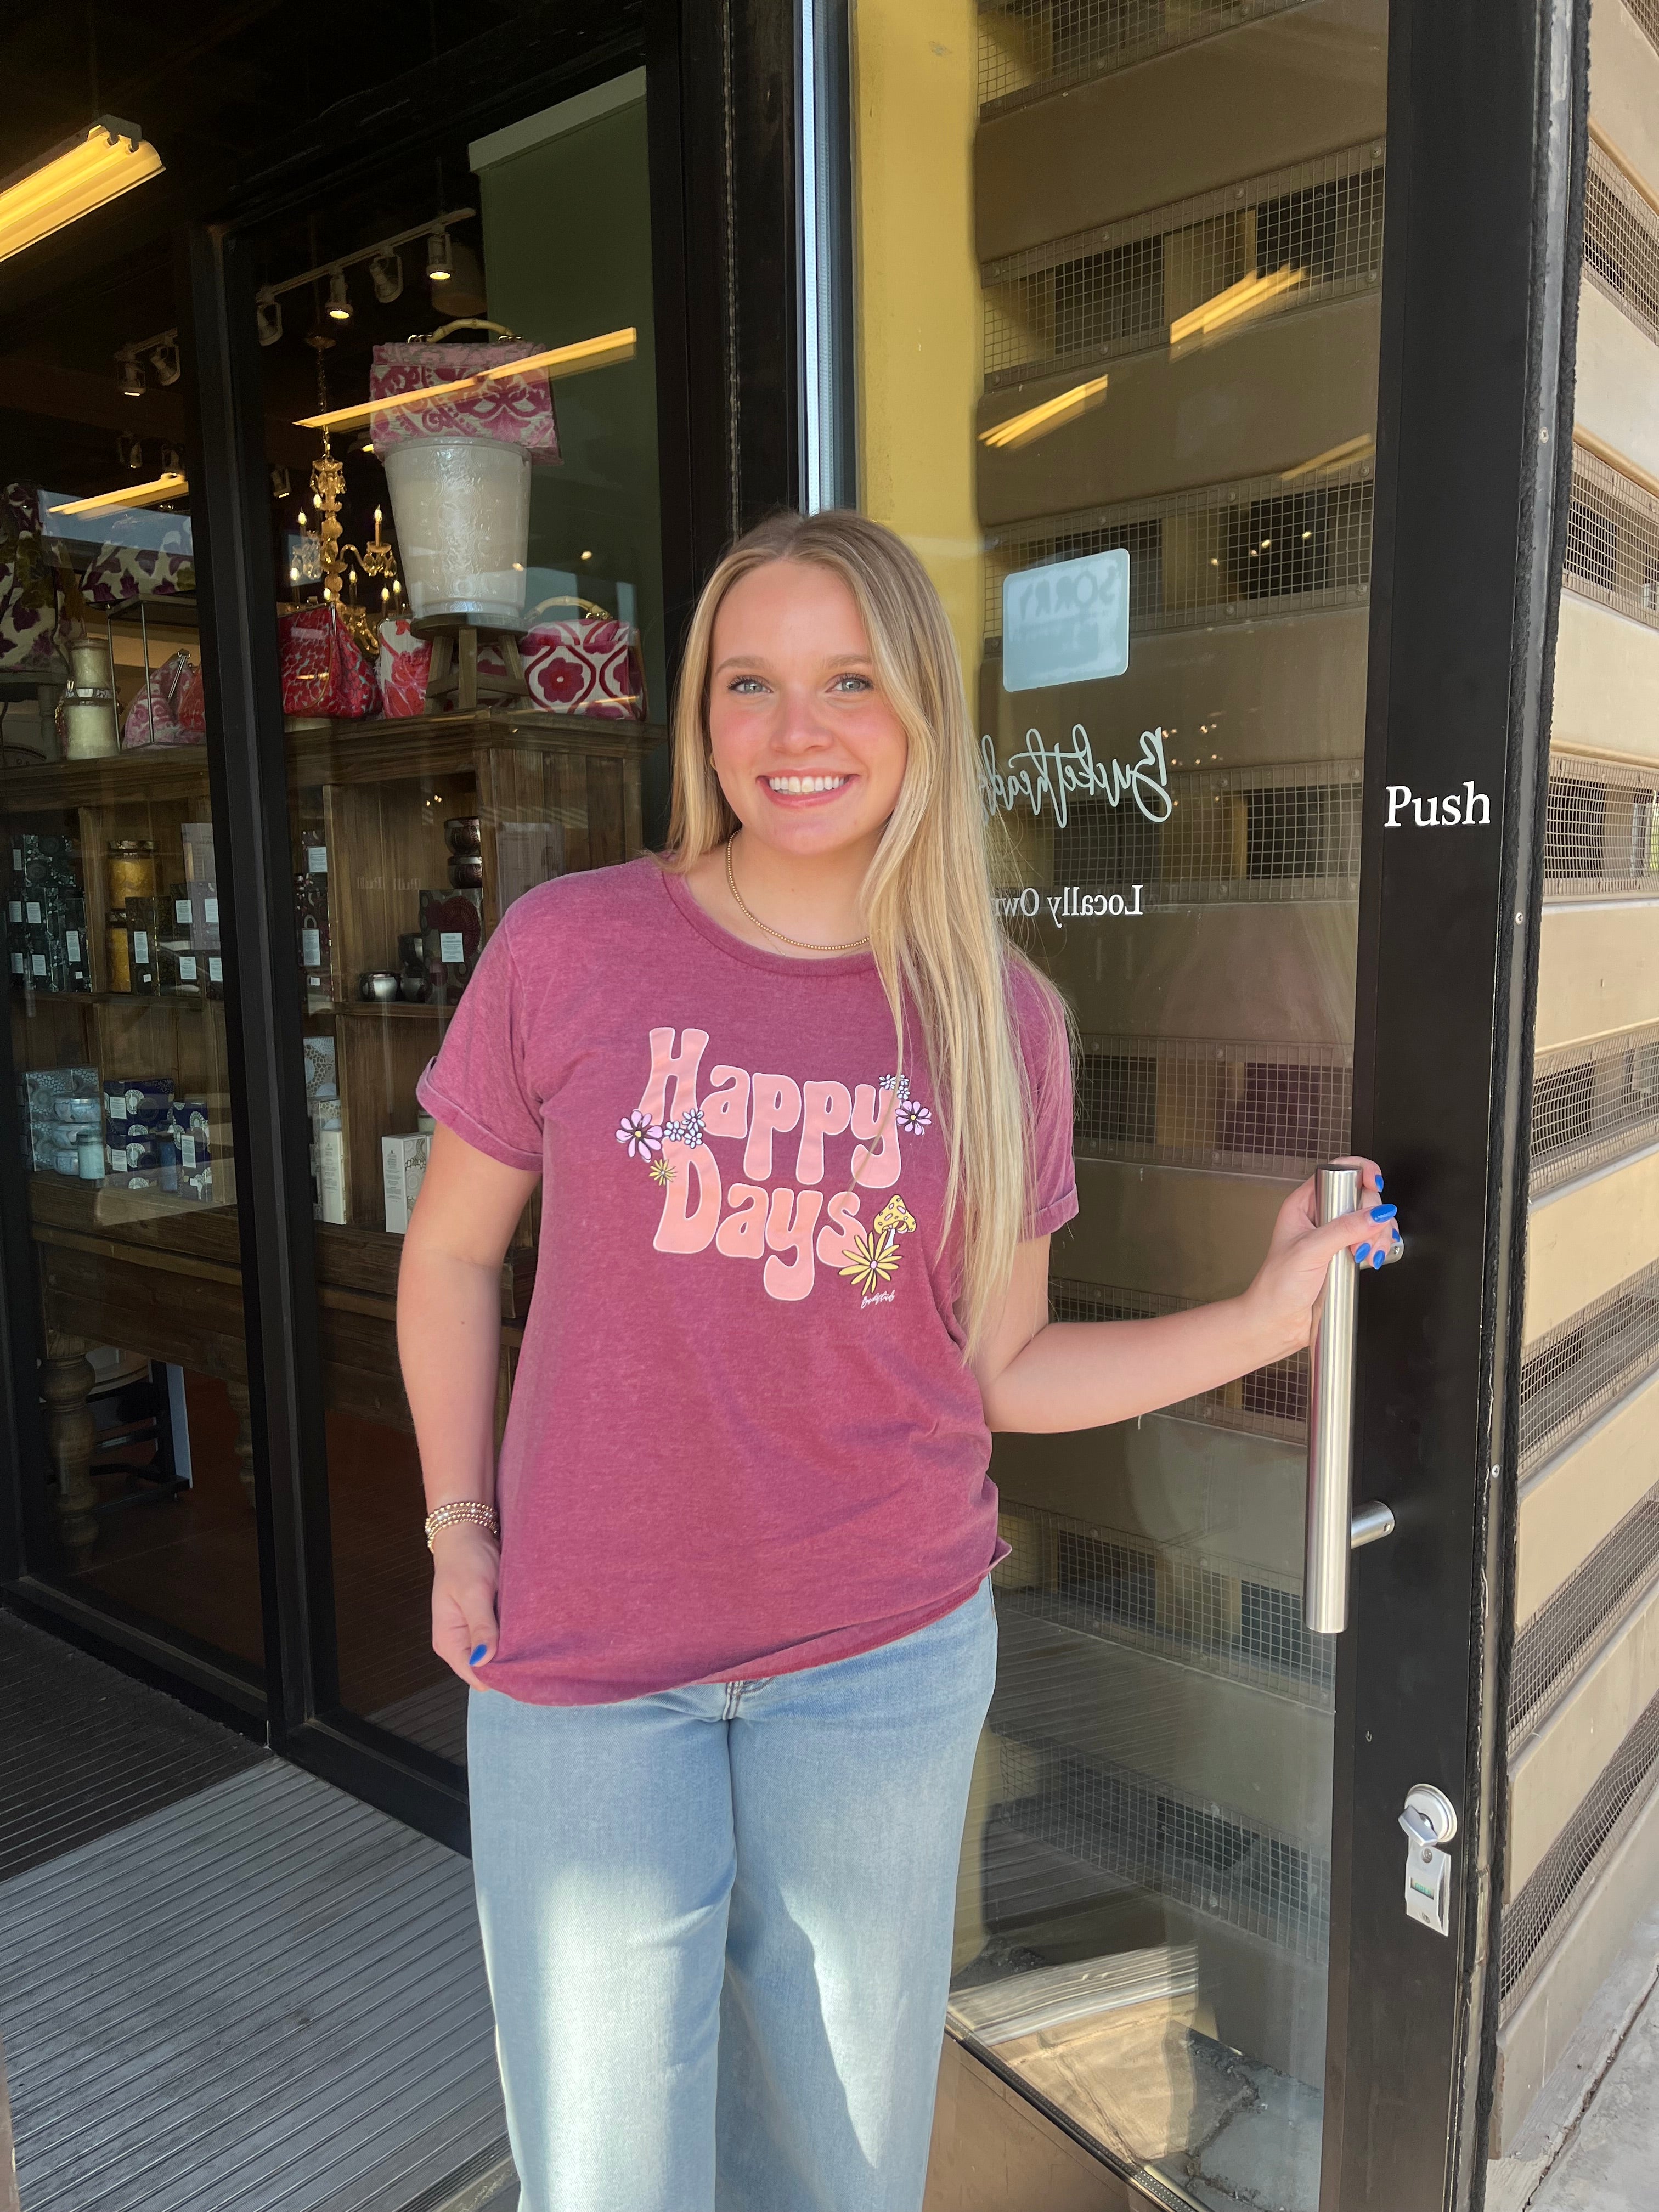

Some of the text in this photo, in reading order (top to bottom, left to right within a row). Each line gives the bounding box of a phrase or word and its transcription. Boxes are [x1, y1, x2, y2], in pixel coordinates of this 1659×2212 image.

[1384, 780, 1491, 827] Push
[637, 1026, 901, 1188] Happy
[652, 1135, 870, 1301] Days
